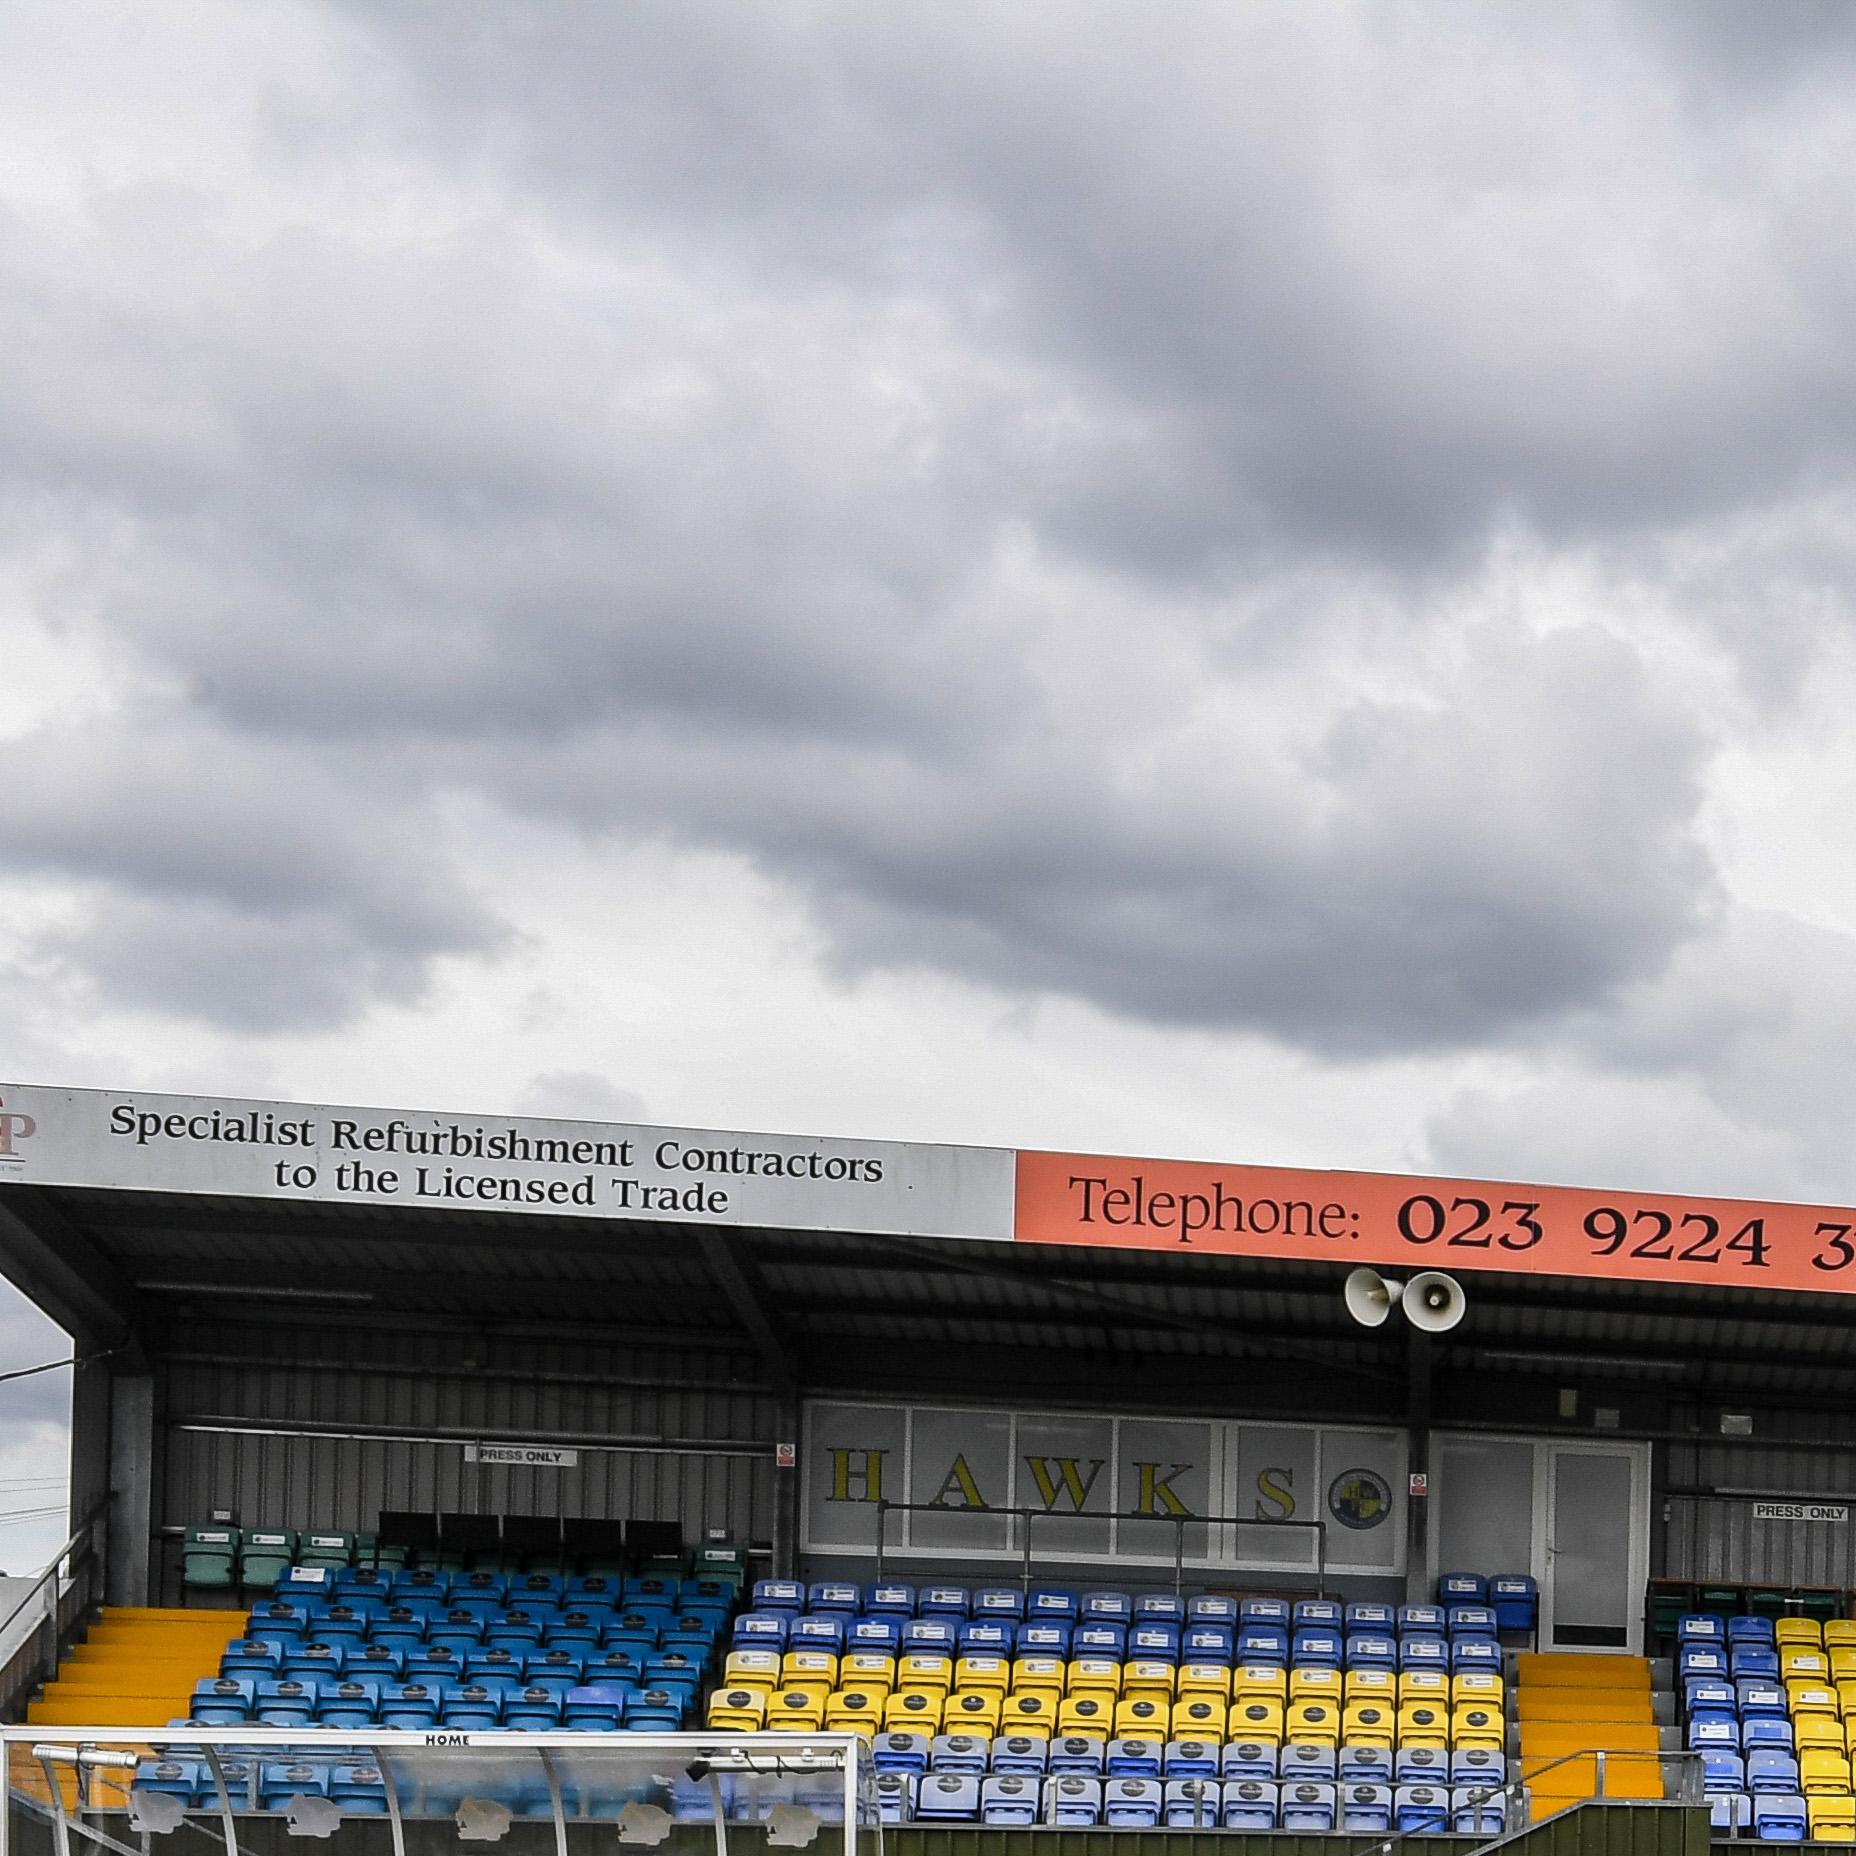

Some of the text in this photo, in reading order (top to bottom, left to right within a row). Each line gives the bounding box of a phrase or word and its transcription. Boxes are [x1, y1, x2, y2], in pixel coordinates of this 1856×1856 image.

[110, 1105, 885, 1183] Specialist Refurbishment Contractors
[275, 1158, 730, 1213] to the Licensed Trade
[1069, 1175, 1361, 1243] Telephone:
[1397, 1194, 1543, 1251] 023
[1583, 1207, 1772, 1267] 9224
[480, 1448, 561, 1463] PRESS ONLY
[1757, 1505, 1845, 1519] PRESS ONLY
[426, 1735, 470, 1746] HOME
